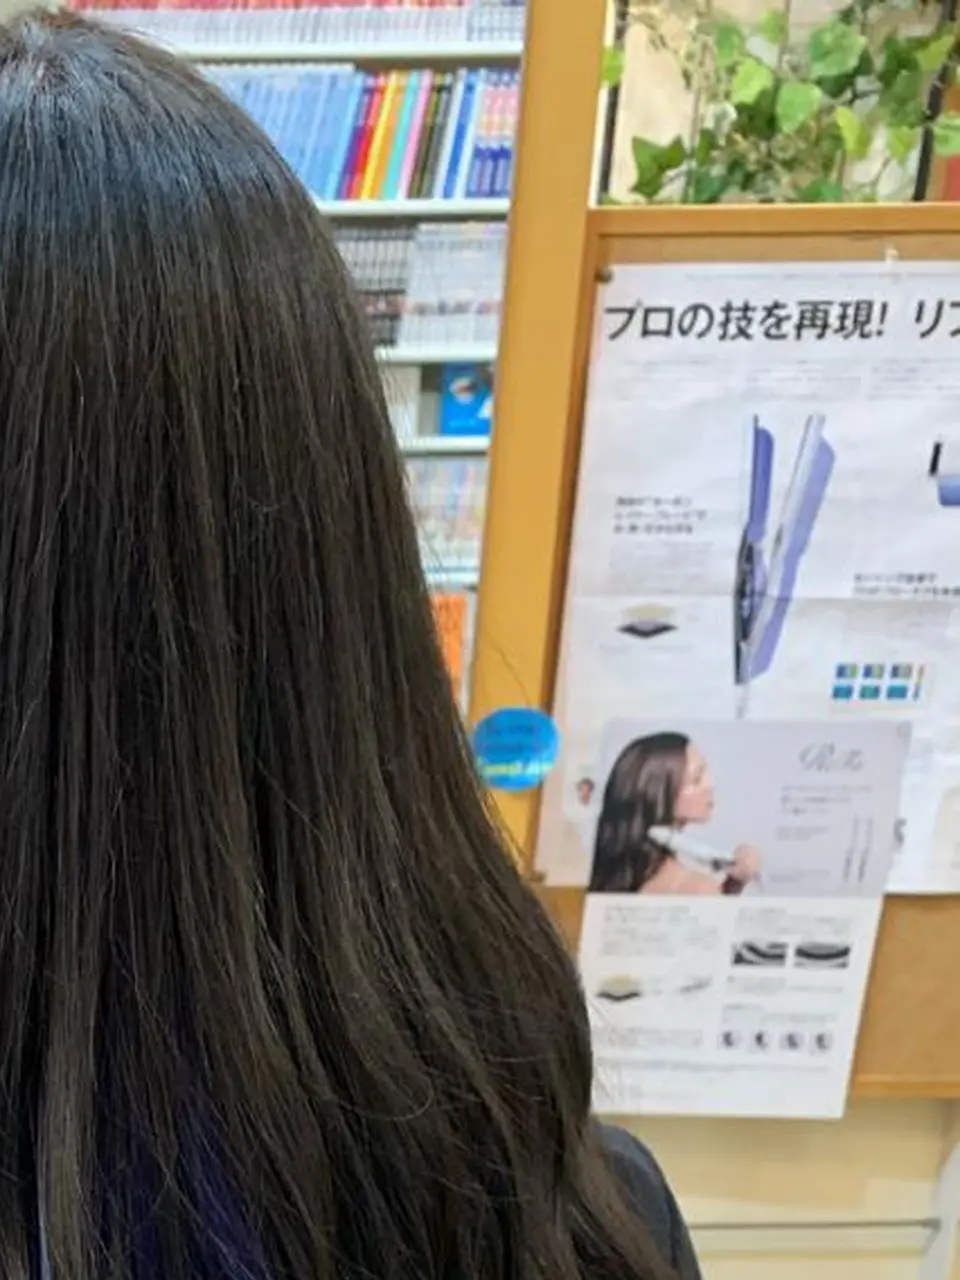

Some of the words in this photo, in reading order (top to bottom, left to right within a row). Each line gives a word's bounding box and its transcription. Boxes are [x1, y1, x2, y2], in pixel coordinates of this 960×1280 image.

[604, 299, 888, 341] プロの技を再現!
